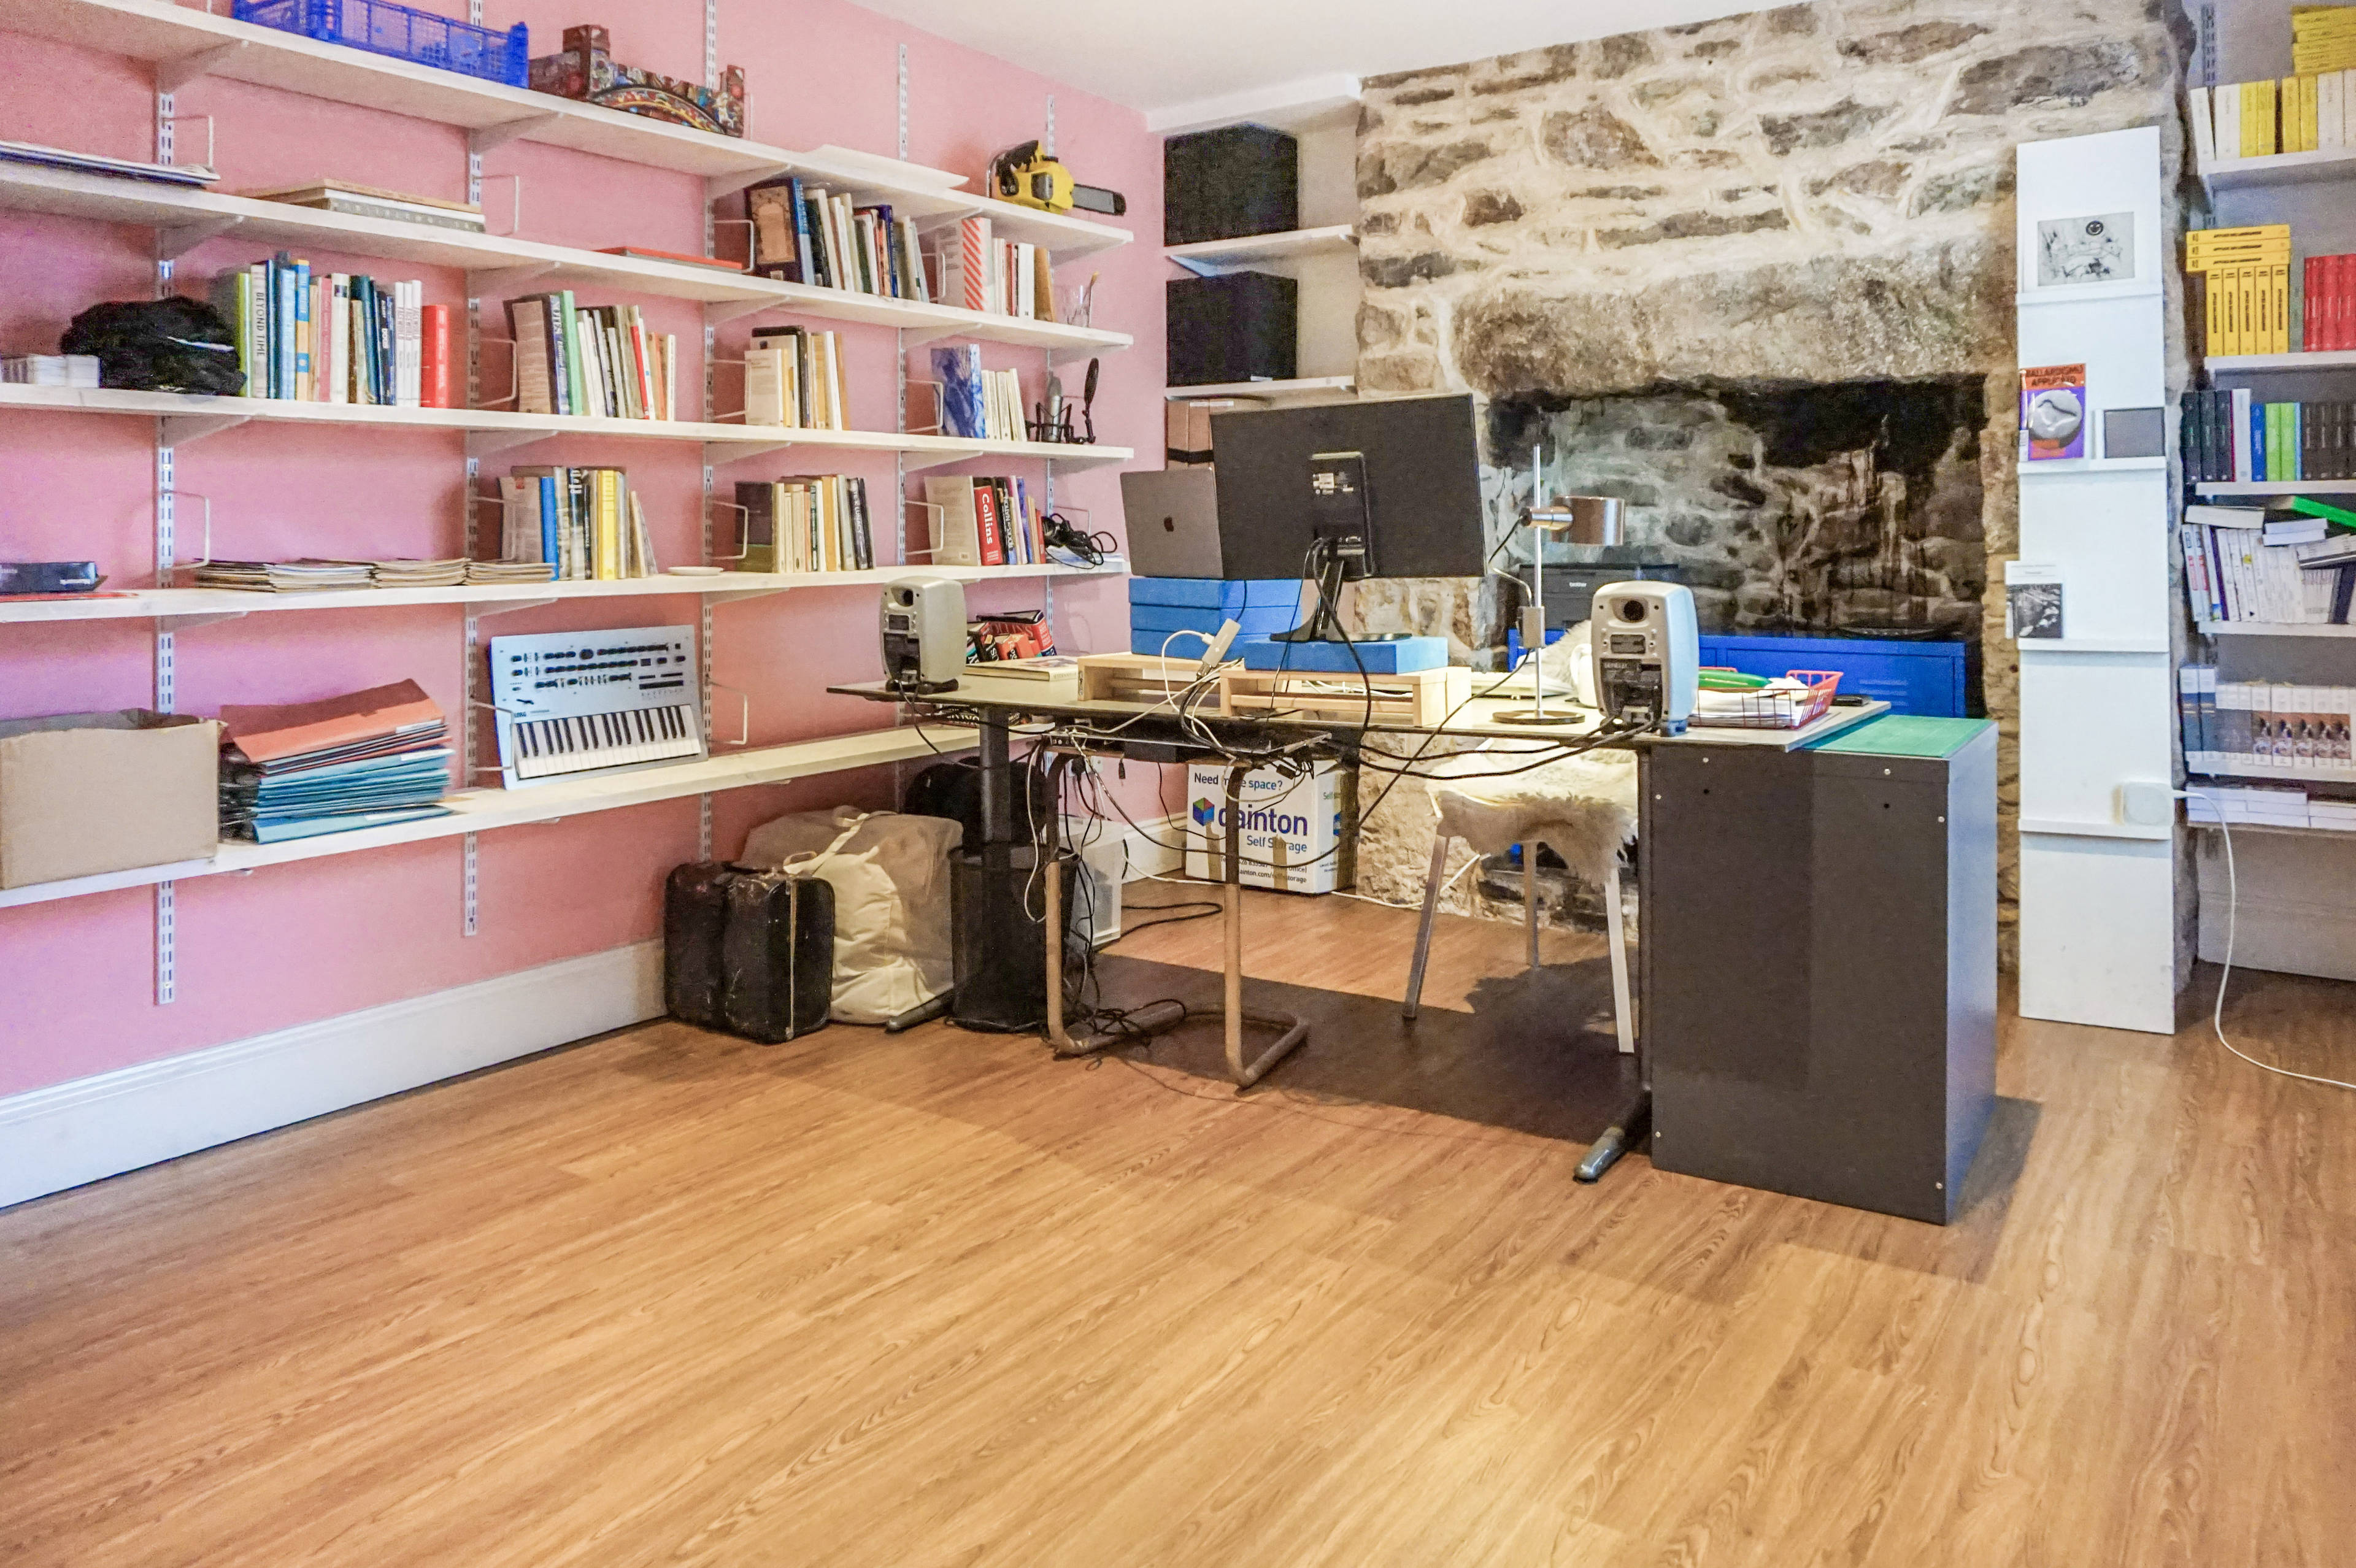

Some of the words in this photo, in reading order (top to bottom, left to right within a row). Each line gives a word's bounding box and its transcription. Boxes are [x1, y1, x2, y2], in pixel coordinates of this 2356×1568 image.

[256, 292, 264, 331] BEYOND
[256, 334, 265, 356] TIME
[982, 493, 993, 545] Collins
[1194, 772, 1218, 785] Need
[1249, 780, 1283, 791] space?
[1247, 835, 1266, 847] Self
[1268, 837, 1307, 854] Sage
